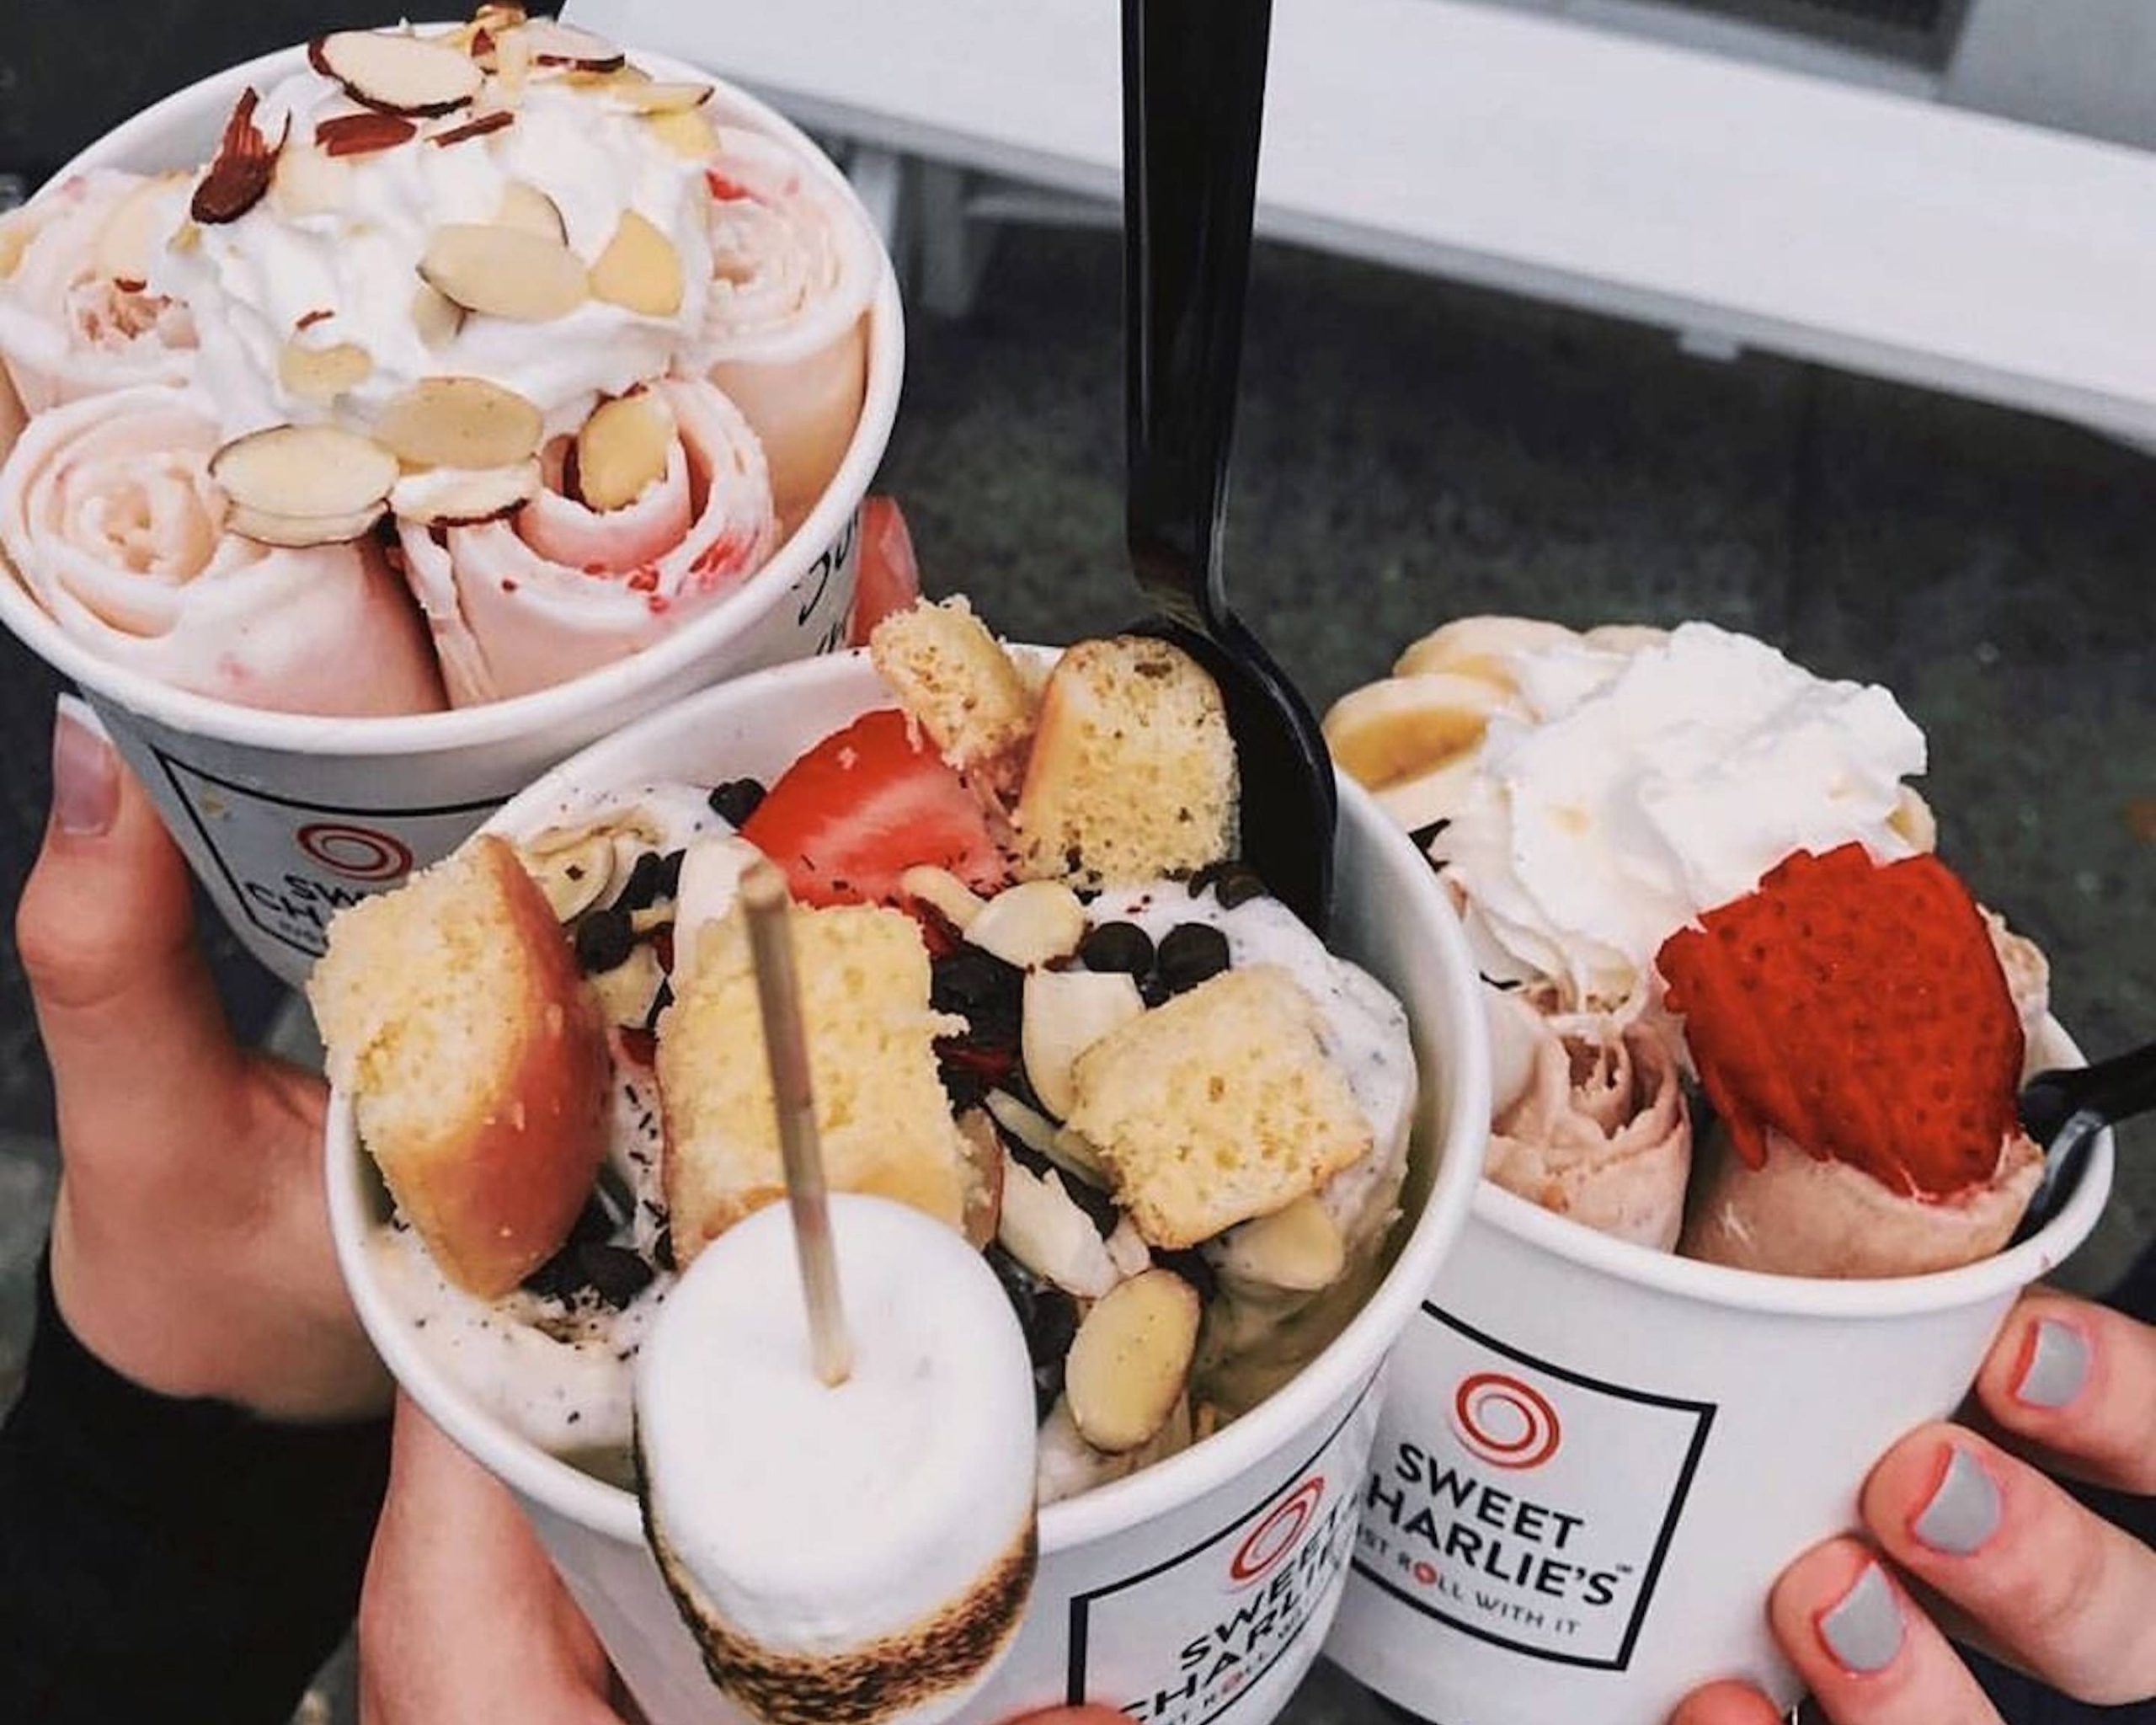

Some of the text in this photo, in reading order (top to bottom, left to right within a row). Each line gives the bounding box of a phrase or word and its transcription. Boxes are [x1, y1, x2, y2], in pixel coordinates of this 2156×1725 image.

[1367, 1474, 1619, 1606] HARLIE'S
[1396, 1443, 1584, 1548] SWEET
[1181, 1494, 1344, 1671] SWEET
[1398, 1551, 1462, 1600] ROLL
[1476, 1590, 1545, 1628] WITH
[1555, 1618, 1581, 1635] IT
